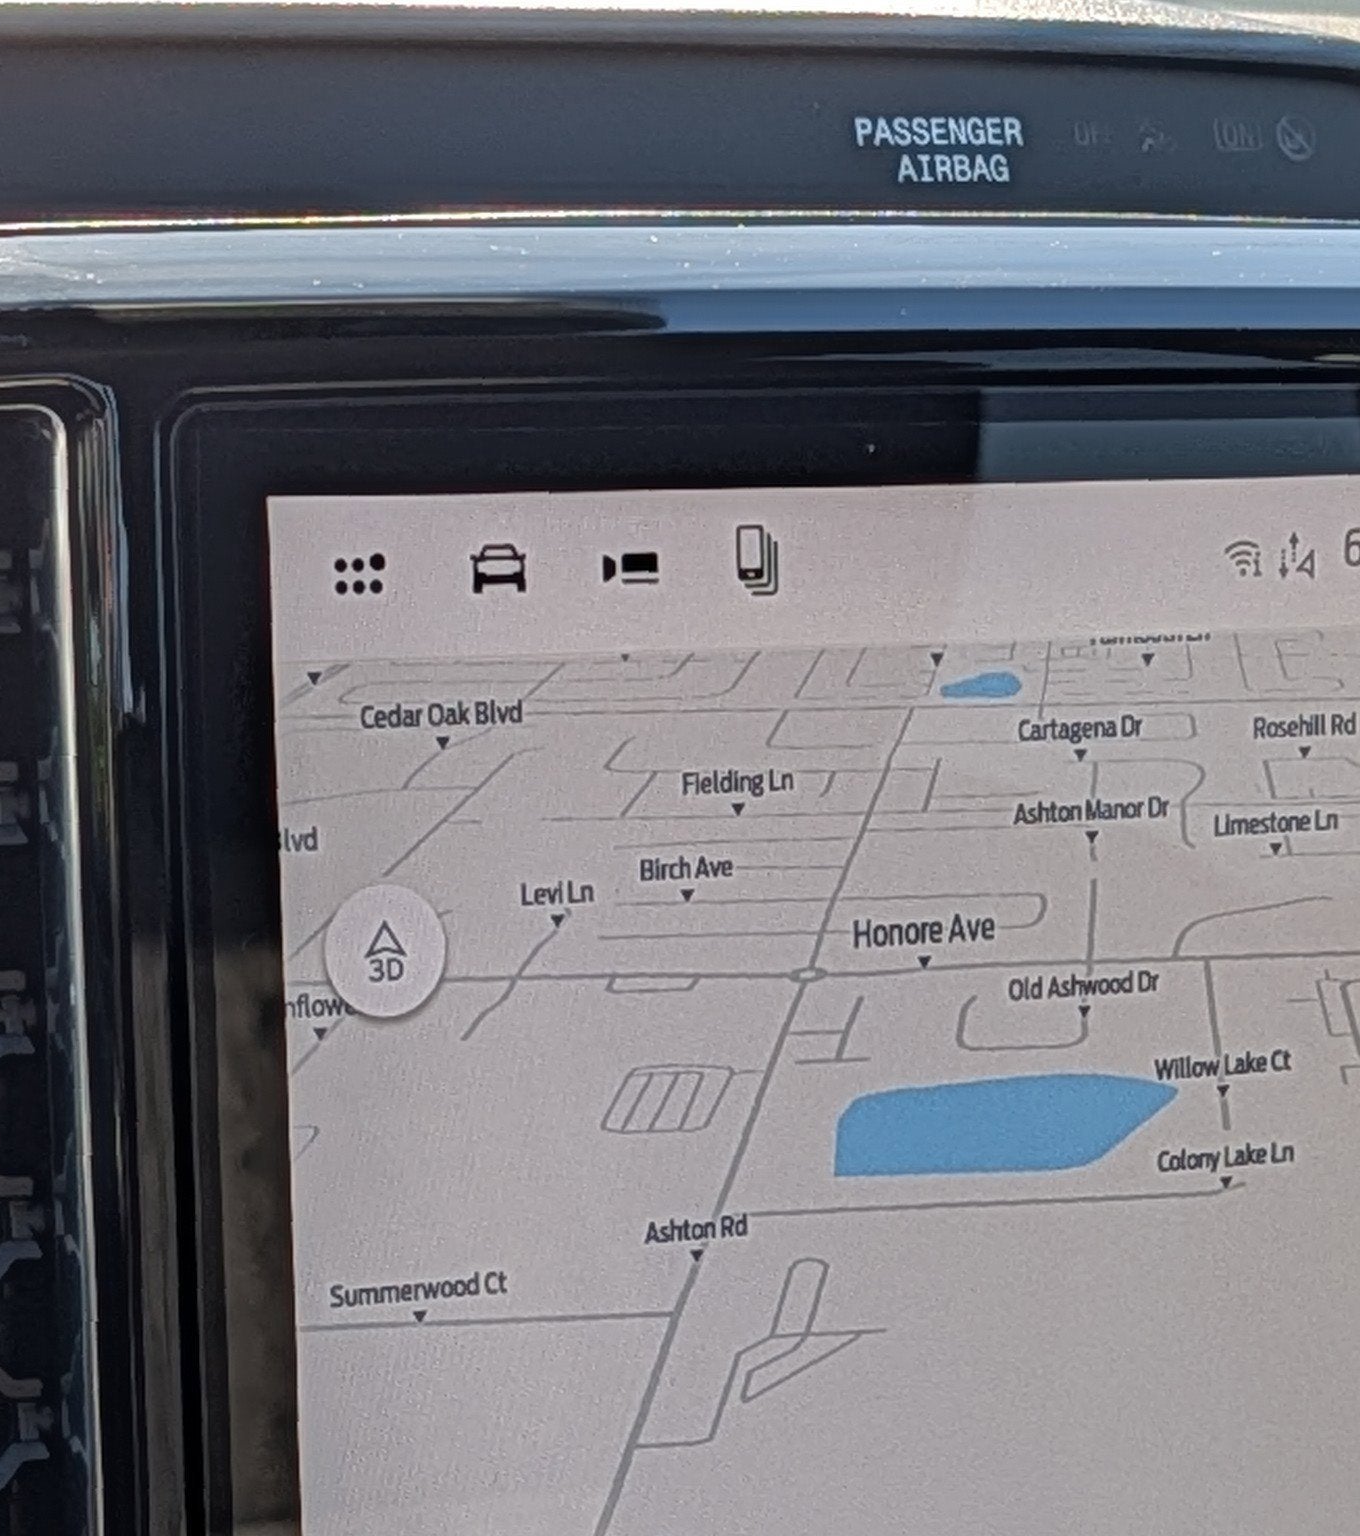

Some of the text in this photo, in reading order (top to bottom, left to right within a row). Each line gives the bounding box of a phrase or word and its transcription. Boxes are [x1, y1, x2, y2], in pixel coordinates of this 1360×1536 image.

[854, 116, 1024, 147] PASSENGER
[897, 154, 1010, 183] AIRBAG
[360, 699, 523, 728] Cedar Oak Blvd
[1252, 712, 1357, 738] Rosehill Rd
[1017, 714, 1143, 744] Cartagena Dr
[681, 768, 794, 798] Fielding Ln
[1013, 796, 1170, 826] Ashton Manor Dr
[1213, 810, 1338, 838] Limestone Ln
[278, 826, 318, 852] lvd
[640, 855, 733, 880] Birch Ave
[521, 879, 594, 906] Levi Ln
[852, 912, 996, 950] Honore Ave
[368, 957, 404, 983] 3D
[1008, 970, 1160, 1000] Old Ashwood Dr
[1154, 1050, 1292, 1080] Willow Lake Ct
[1157, 1143, 1295, 1177] Colony Lake Ln
[644, 1215, 749, 1244] Ashton Rd
[330, 1271, 508, 1308] Summerwood Ct
